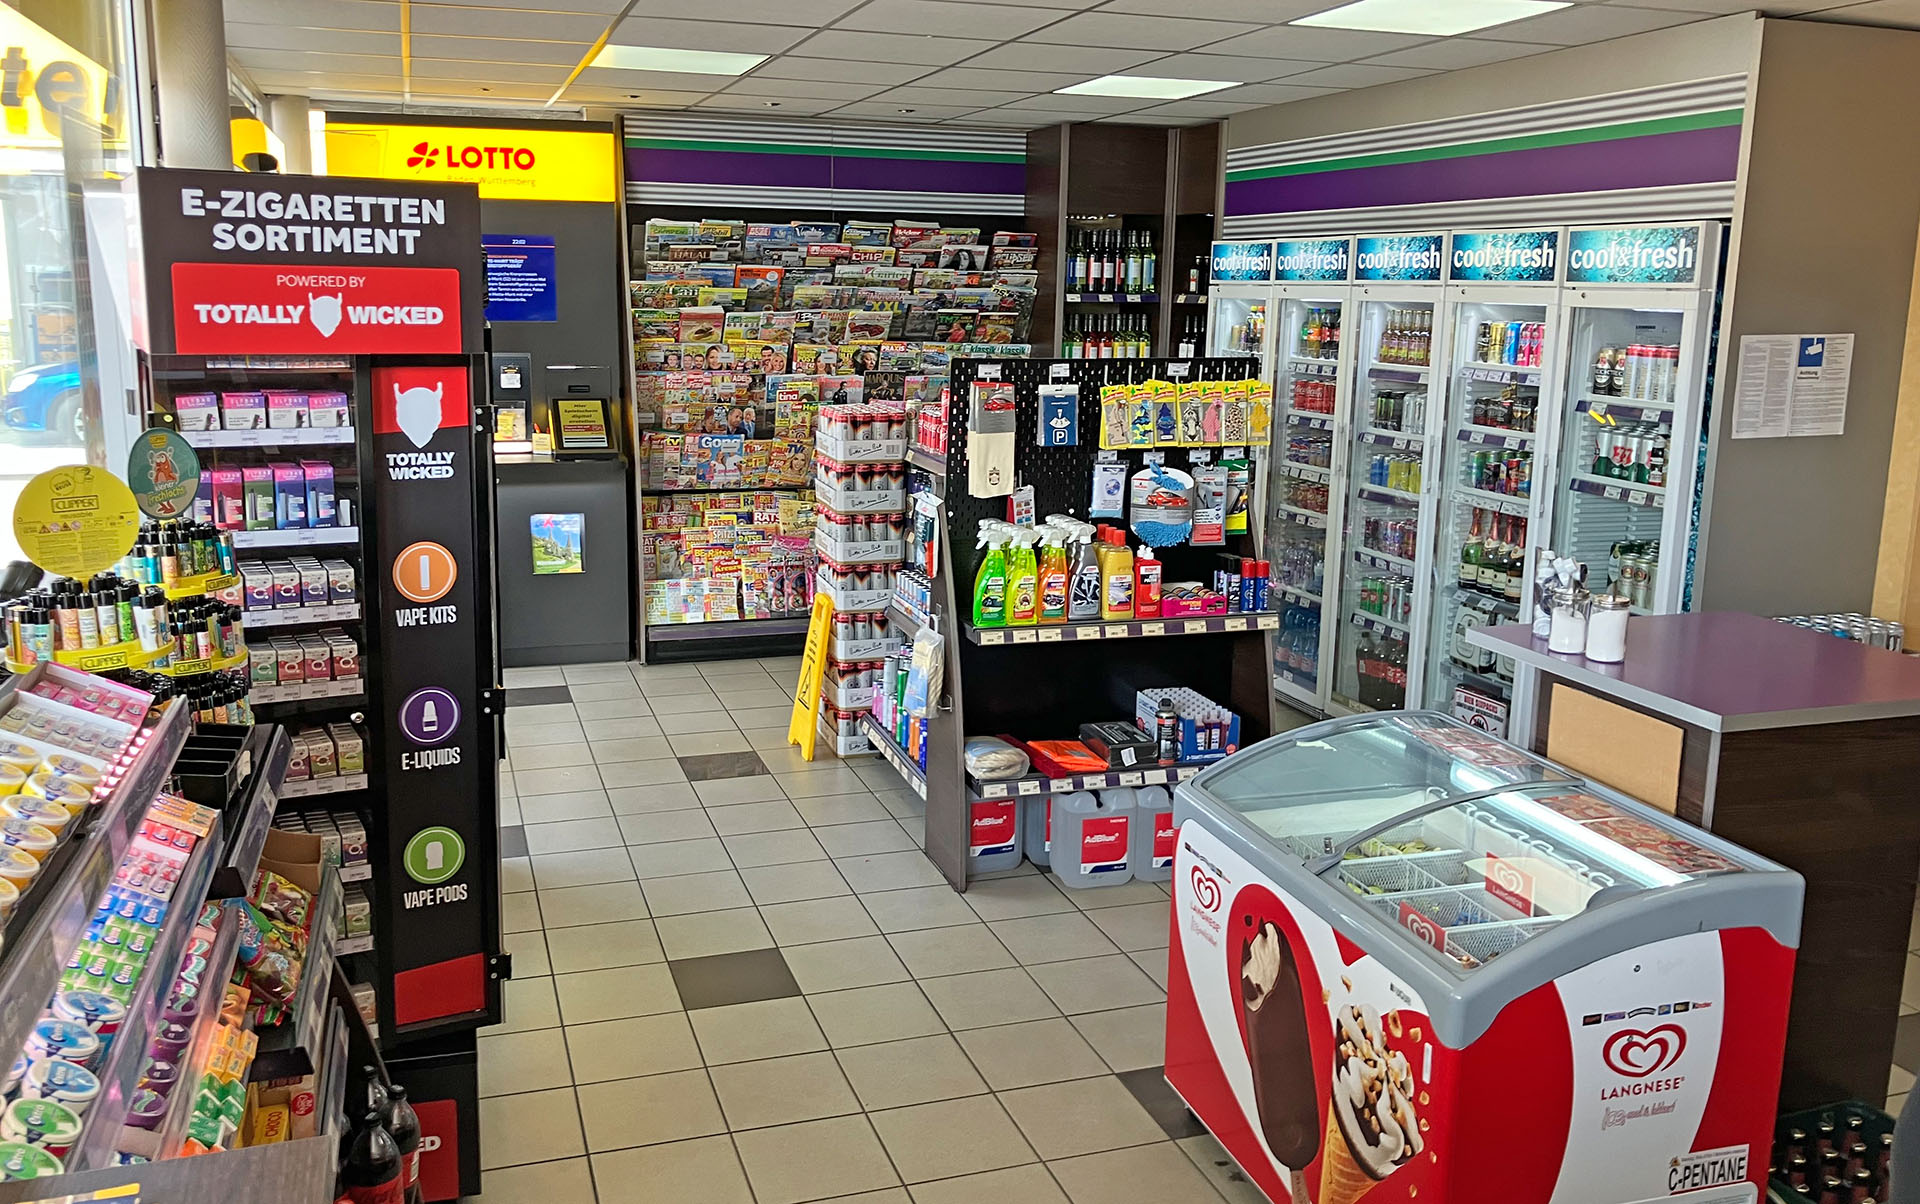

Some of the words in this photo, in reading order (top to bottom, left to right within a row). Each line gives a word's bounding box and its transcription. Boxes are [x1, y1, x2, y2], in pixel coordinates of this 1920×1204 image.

[447, 146, 535, 170] LOTTO
[181, 189, 445, 225] E-ZIGARETTEN
[212, 223, 421, 255] SORTIMENT
[852, 252, 883, 261] CHIP
[276, 274, 346, 288] POWERED
[350, 276, 365, 289] BY
[194, 303, 305, 325] TOTALLY
[347, 304, 444, 325] WICKED
[872, 302, 903, 313] XXL
[779, 392, 798, 400] tina
[386, 452, 455, 467] TOTALLY
[389, 466, 455, 480] WICKED
[55, 499, 96, 510] CLIPPER
[396, 608, 427, 627] VAPE
[430, 605, 457, 624] KITS
[84, 656, 124, 669] CLIPPER
[177, 662, 209, 673] CLIPPER
[401, 746, 461, 770] E-LIQUIDS
[1084, 832, 1119, 844] AdBlue
[403, 889, 434, 909] VAPE
[436, 883, 468, 904] PODS
[1668, 1156, 1746, 1191] C-PENTANE
